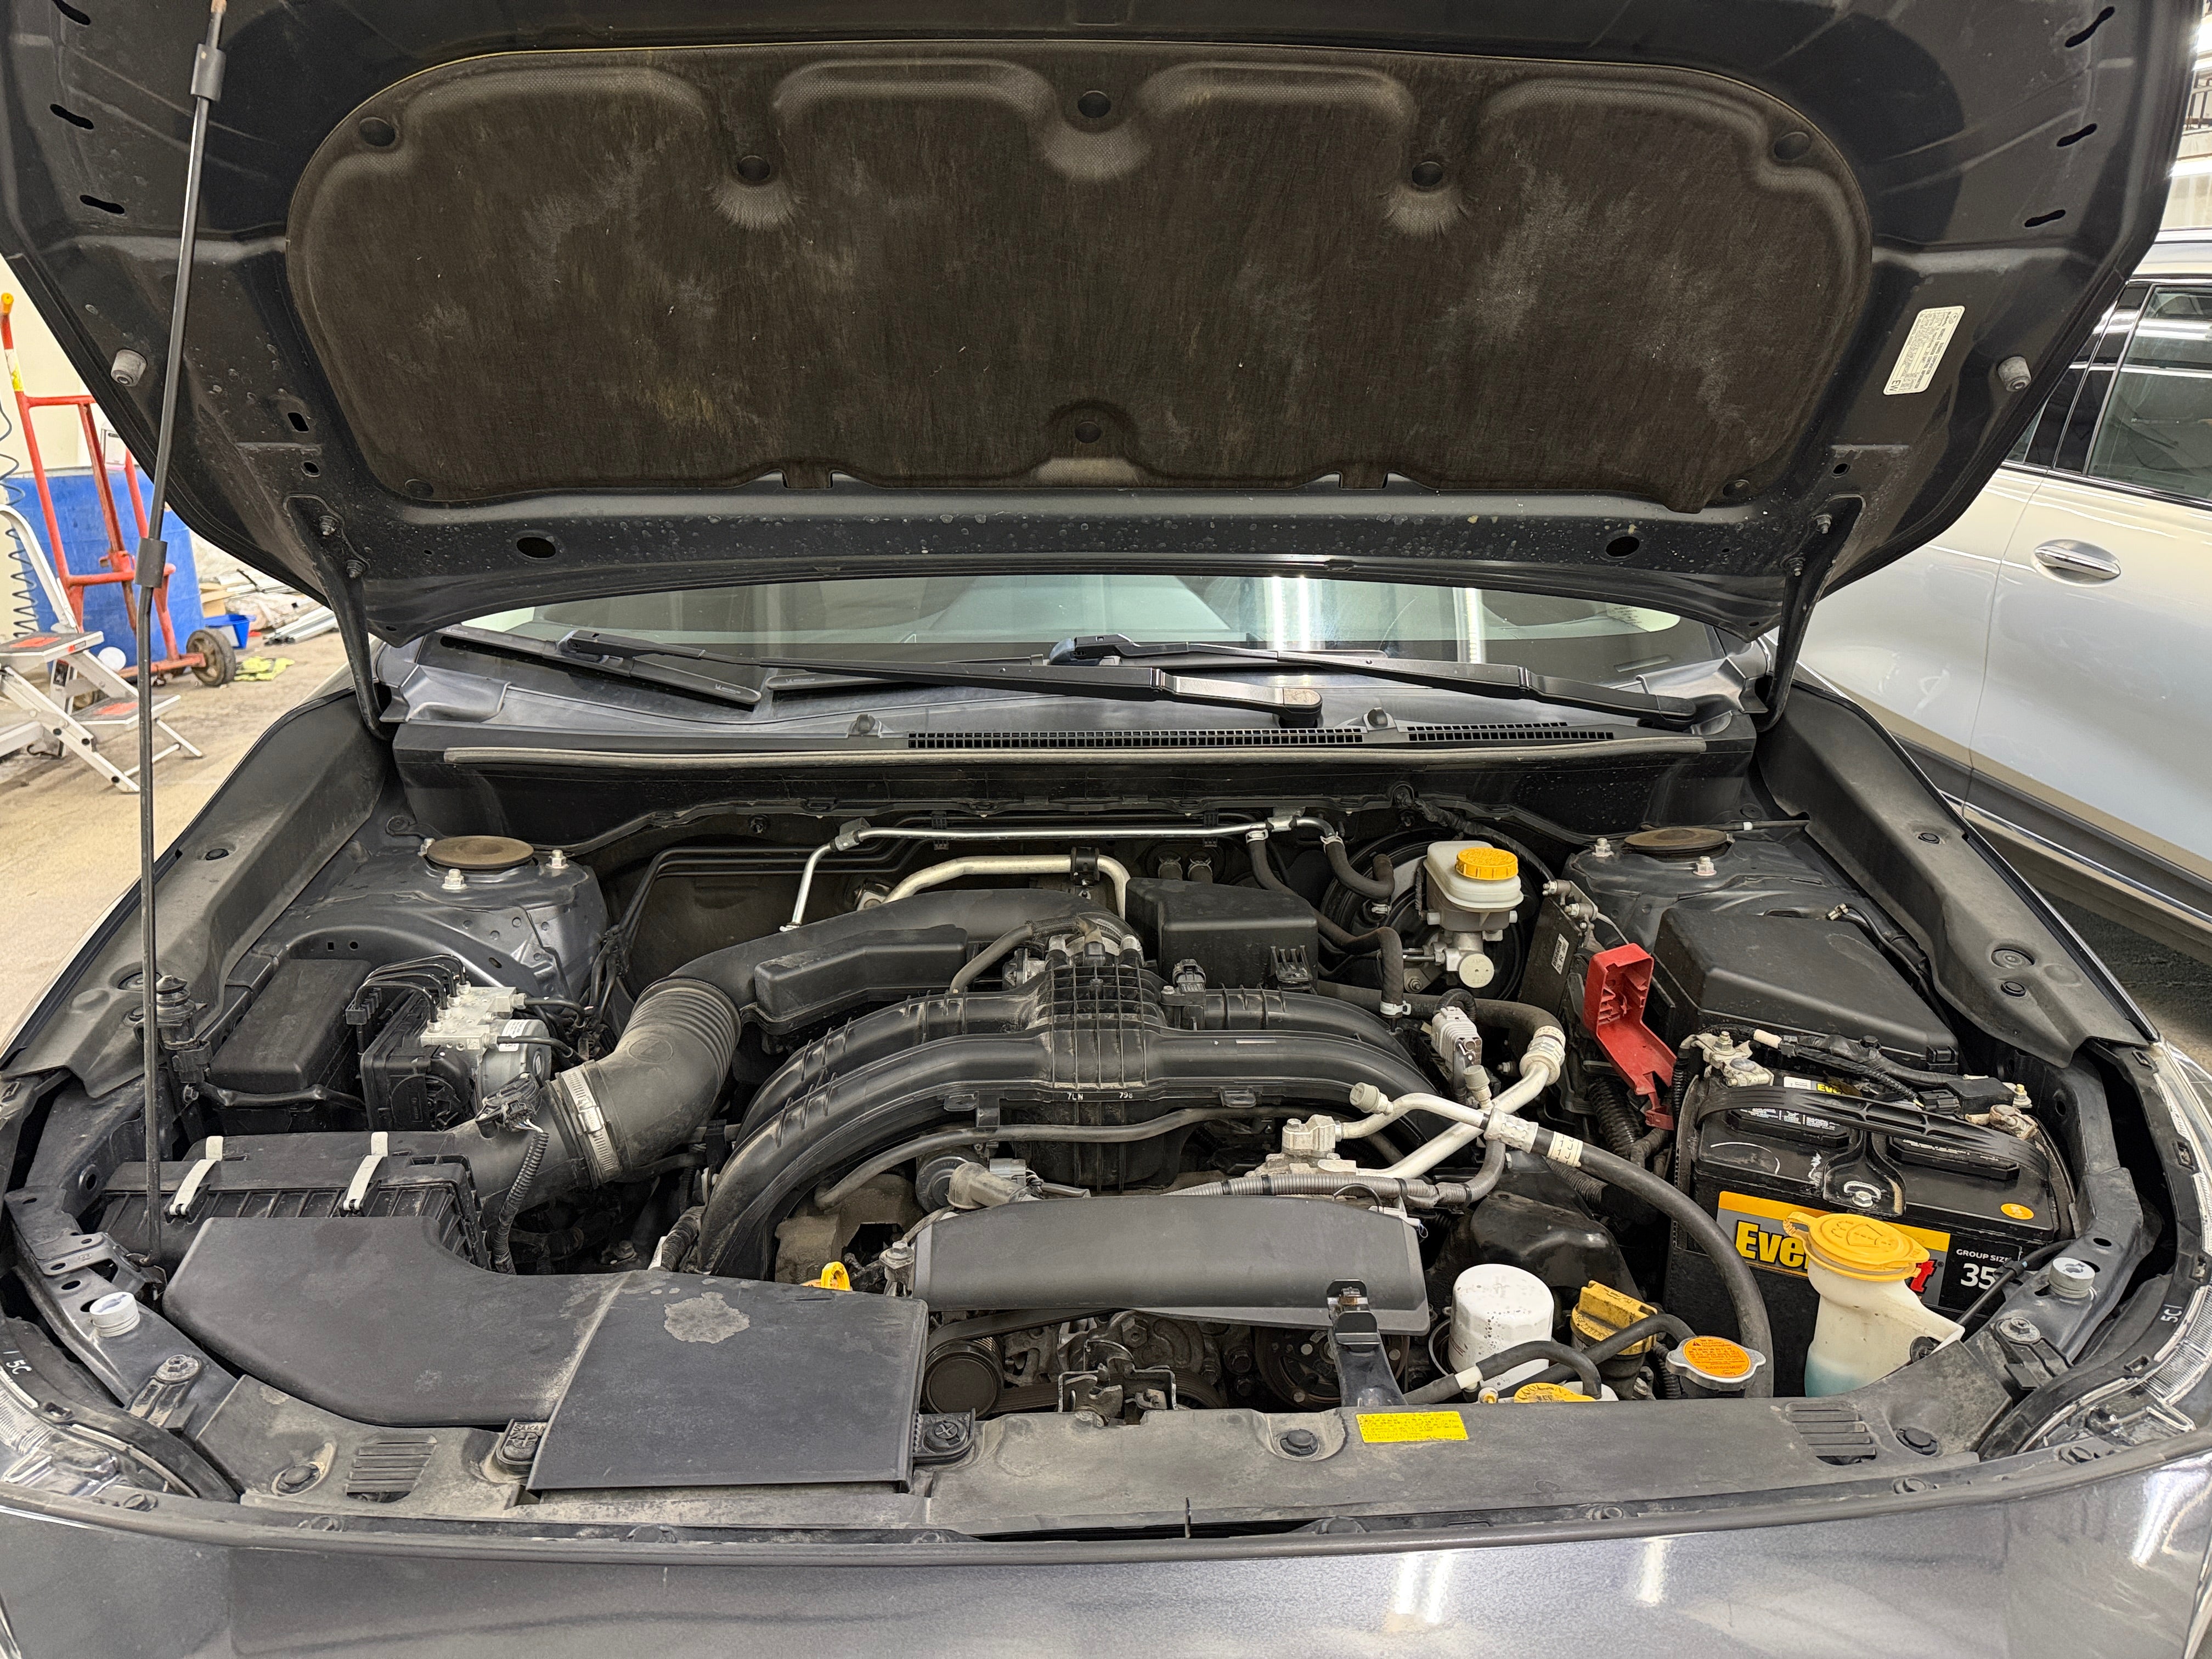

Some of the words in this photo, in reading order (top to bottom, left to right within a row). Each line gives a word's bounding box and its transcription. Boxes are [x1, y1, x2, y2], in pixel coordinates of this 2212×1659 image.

[1889, 380, 1901, 392] EW
[1735, 1220, 1809, 1272] Eve
[1956, 1249, 1989, 1260] GROUP
[1960, 1262, 1998, 1290] 35
